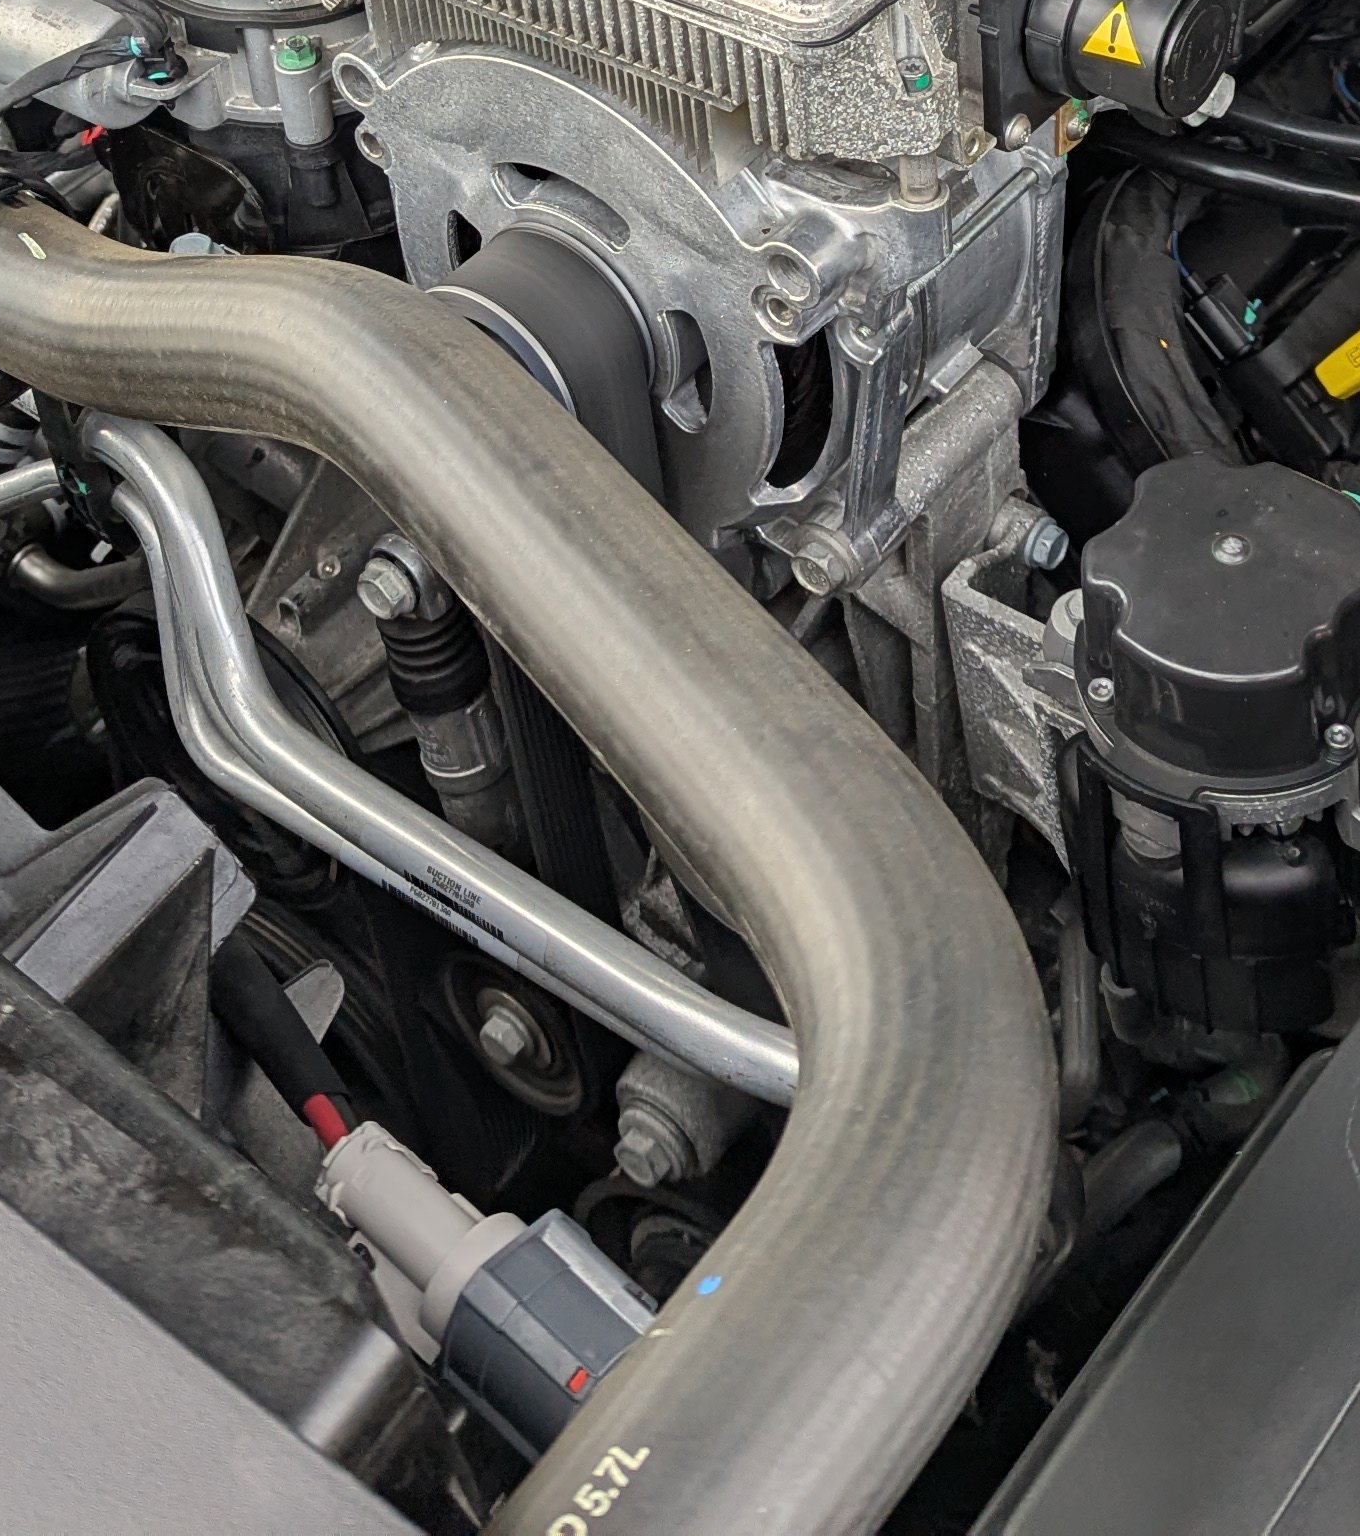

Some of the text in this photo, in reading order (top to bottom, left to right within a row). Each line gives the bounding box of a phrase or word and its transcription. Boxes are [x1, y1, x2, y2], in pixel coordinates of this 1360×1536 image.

[427, 865, 483, 905] SUCTION LINE
[571, 1445, 651, 1517] 5.7L
